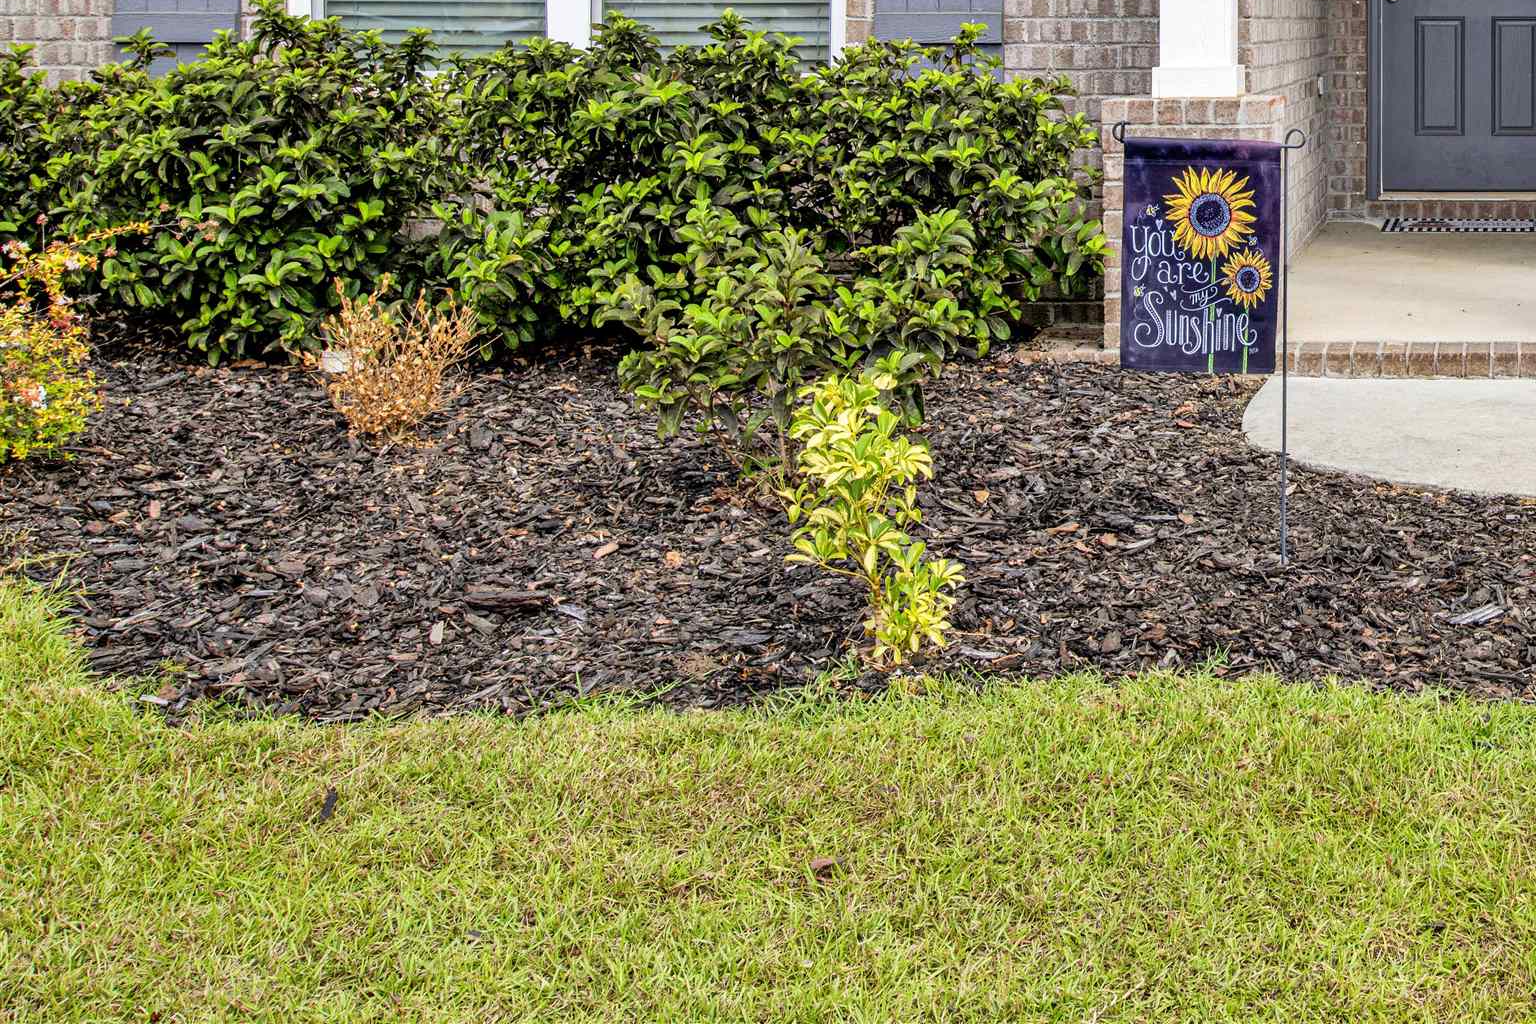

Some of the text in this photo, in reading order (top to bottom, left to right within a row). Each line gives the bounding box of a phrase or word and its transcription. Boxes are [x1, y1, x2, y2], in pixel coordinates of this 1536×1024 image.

[1157, 260, 1210, 285] are
[1189, 286, 1218, 306] my
[1134, 290, 1258, 355] Sunshine
